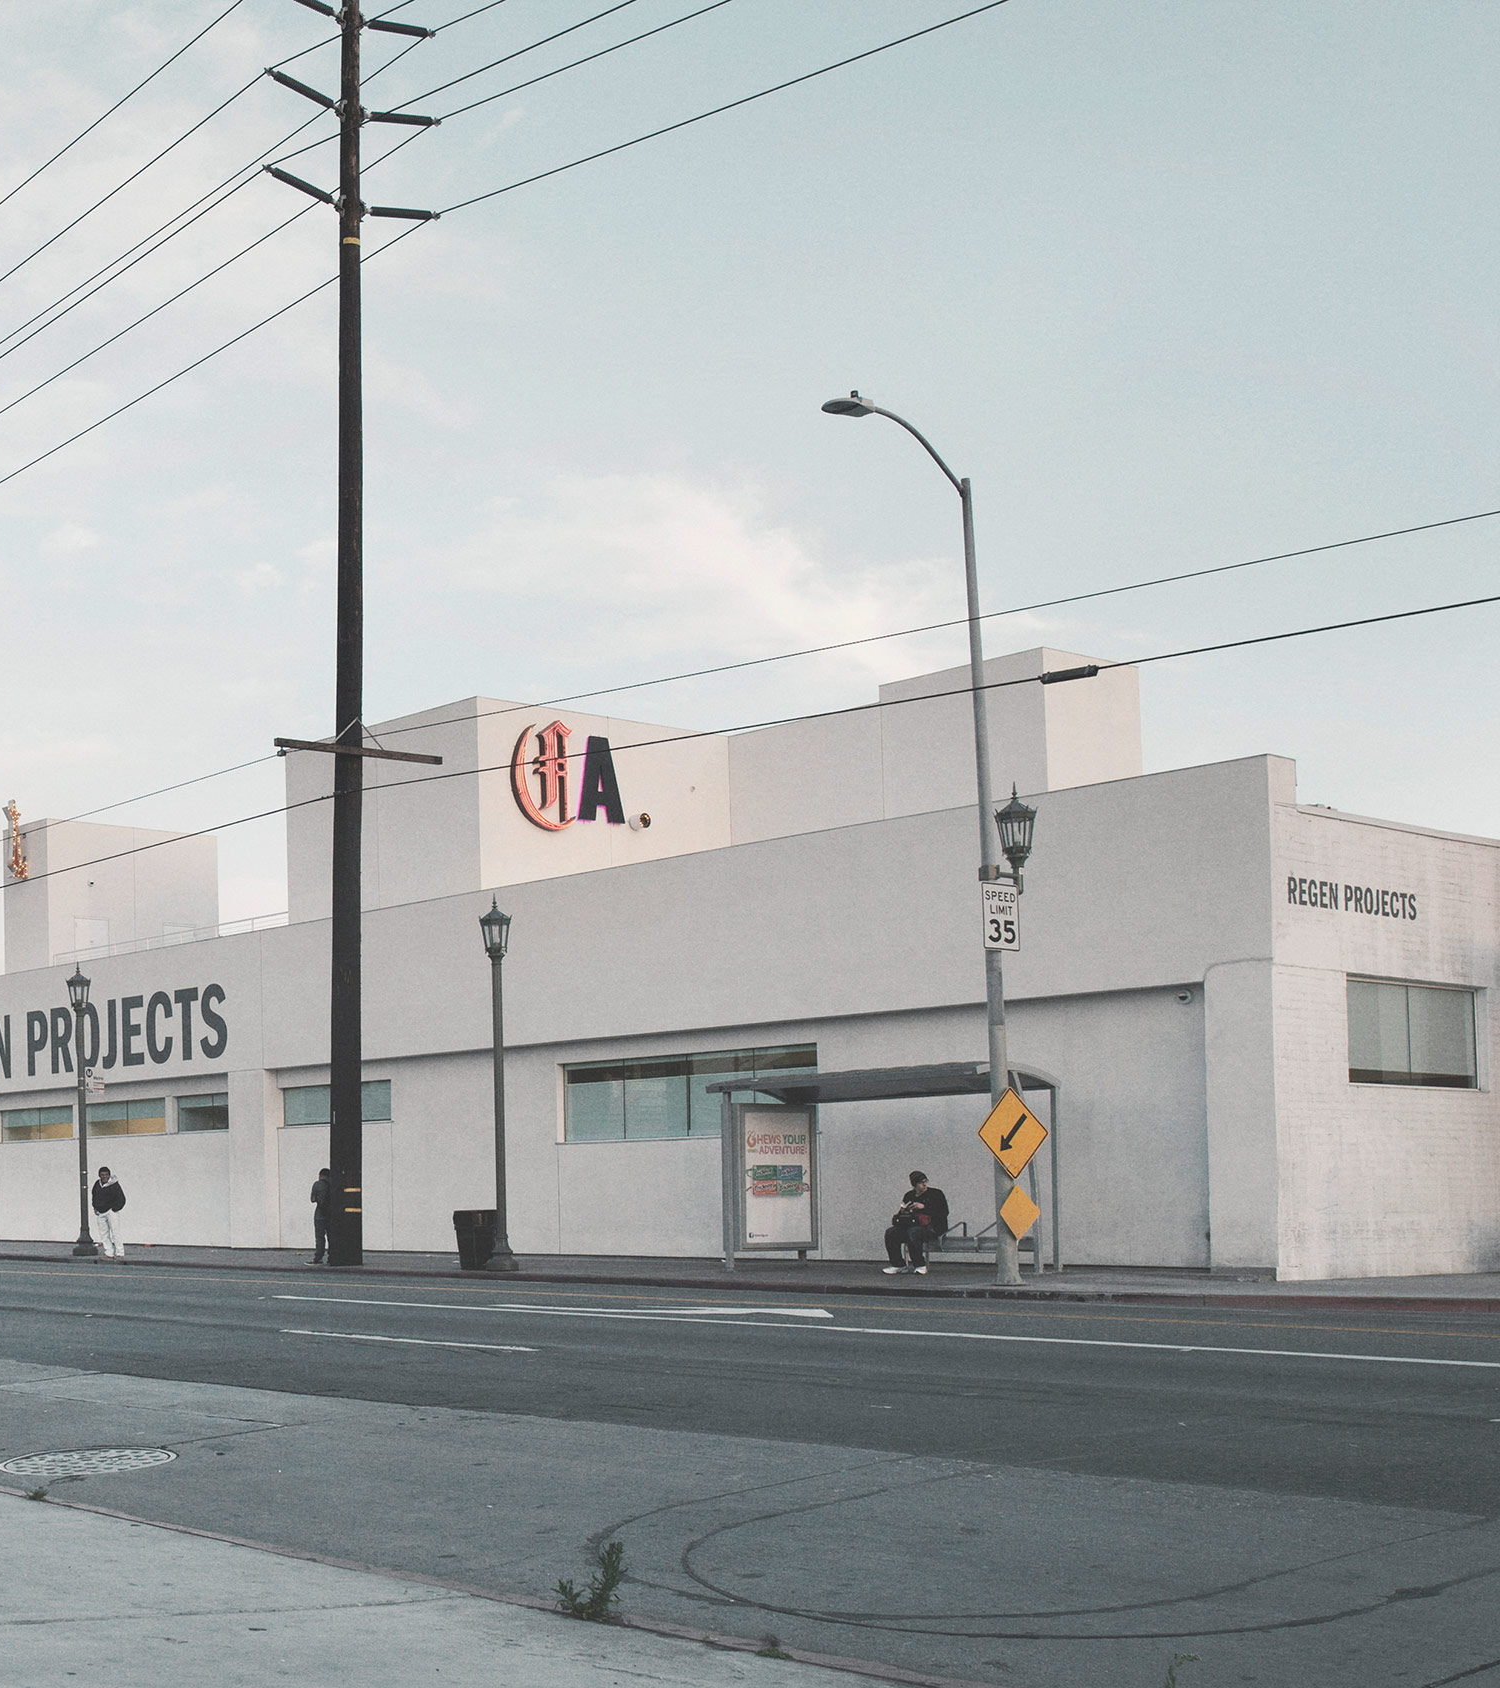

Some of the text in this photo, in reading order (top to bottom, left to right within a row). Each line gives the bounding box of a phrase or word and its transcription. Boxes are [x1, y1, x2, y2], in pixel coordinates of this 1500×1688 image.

[985, 890, 1016, 903] SPEED
[1287, 876, 1417, 921] REGEN PROJECTS
[990, 904, 1012, 916] LIMIT
[988, 918, 1016, 944] 35
[26, 983, 228, 1077] PROJECTS
[782, 1134, 806, 1145] YOUR
